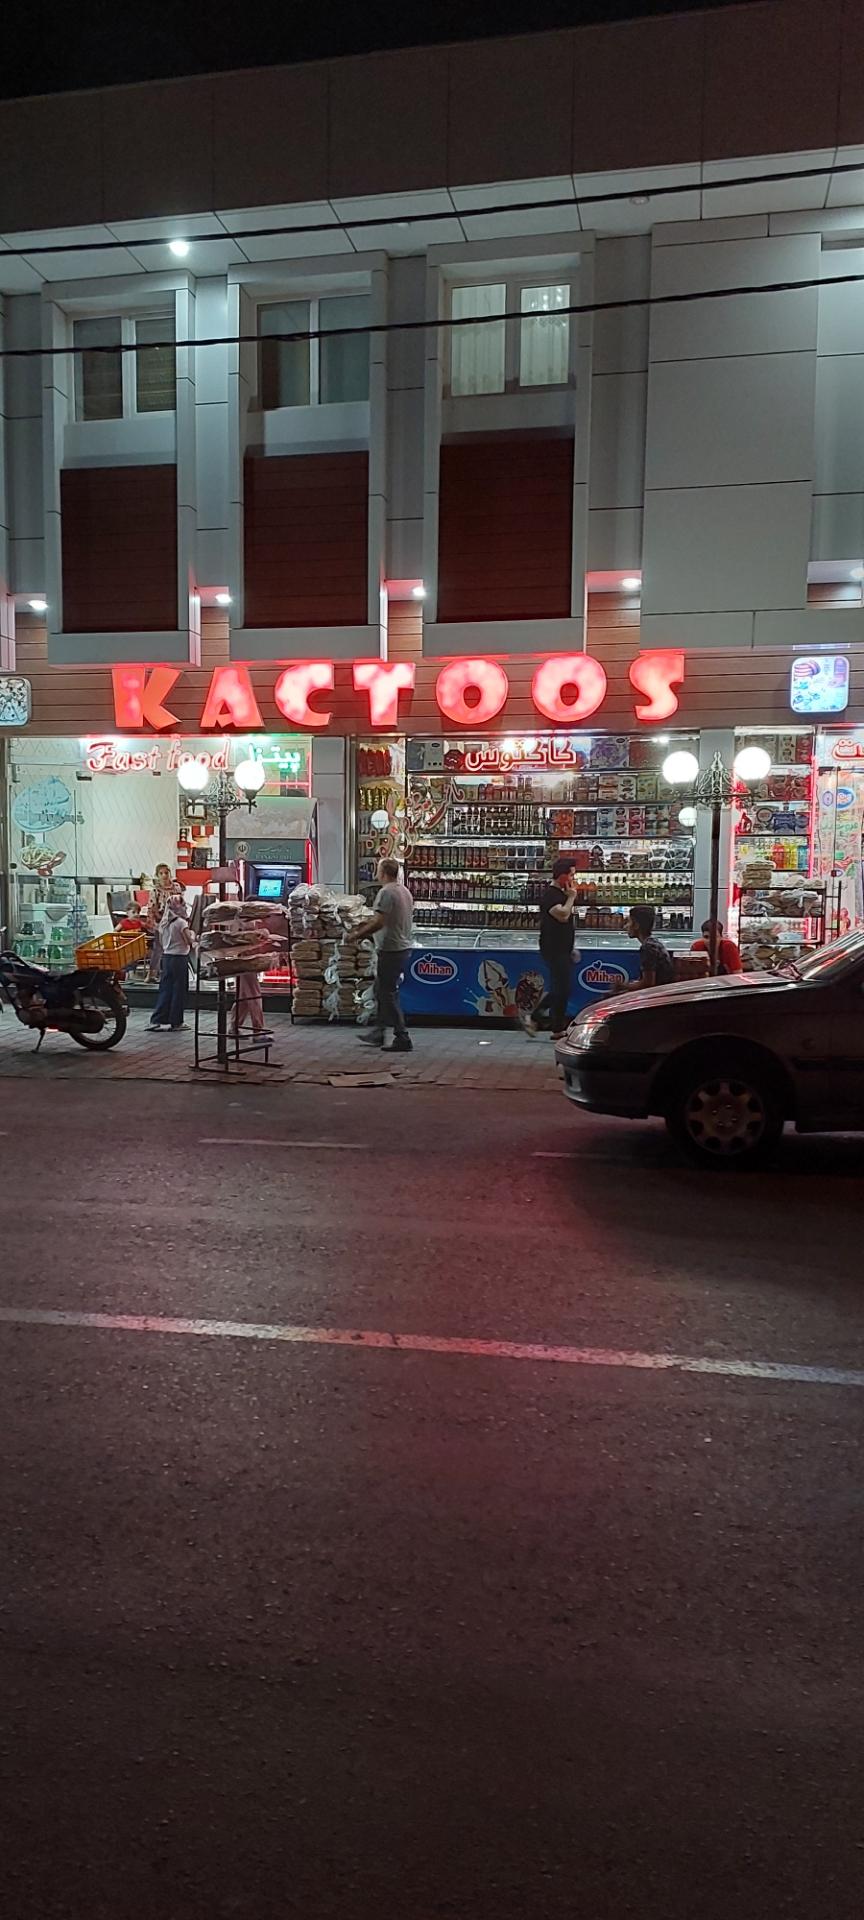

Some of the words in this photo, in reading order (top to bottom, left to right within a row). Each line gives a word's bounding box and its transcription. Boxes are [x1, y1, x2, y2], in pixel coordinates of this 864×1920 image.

[111, 653, 685, 729] KACTOOS
[87, 741, 162, 771] Fast
[166, 737, 231, 770] food
[465, 737, 576, 771] کاکتوس
[418, 962, 452, 976] Mihan
[587, 970, 624, 984] Mihan
